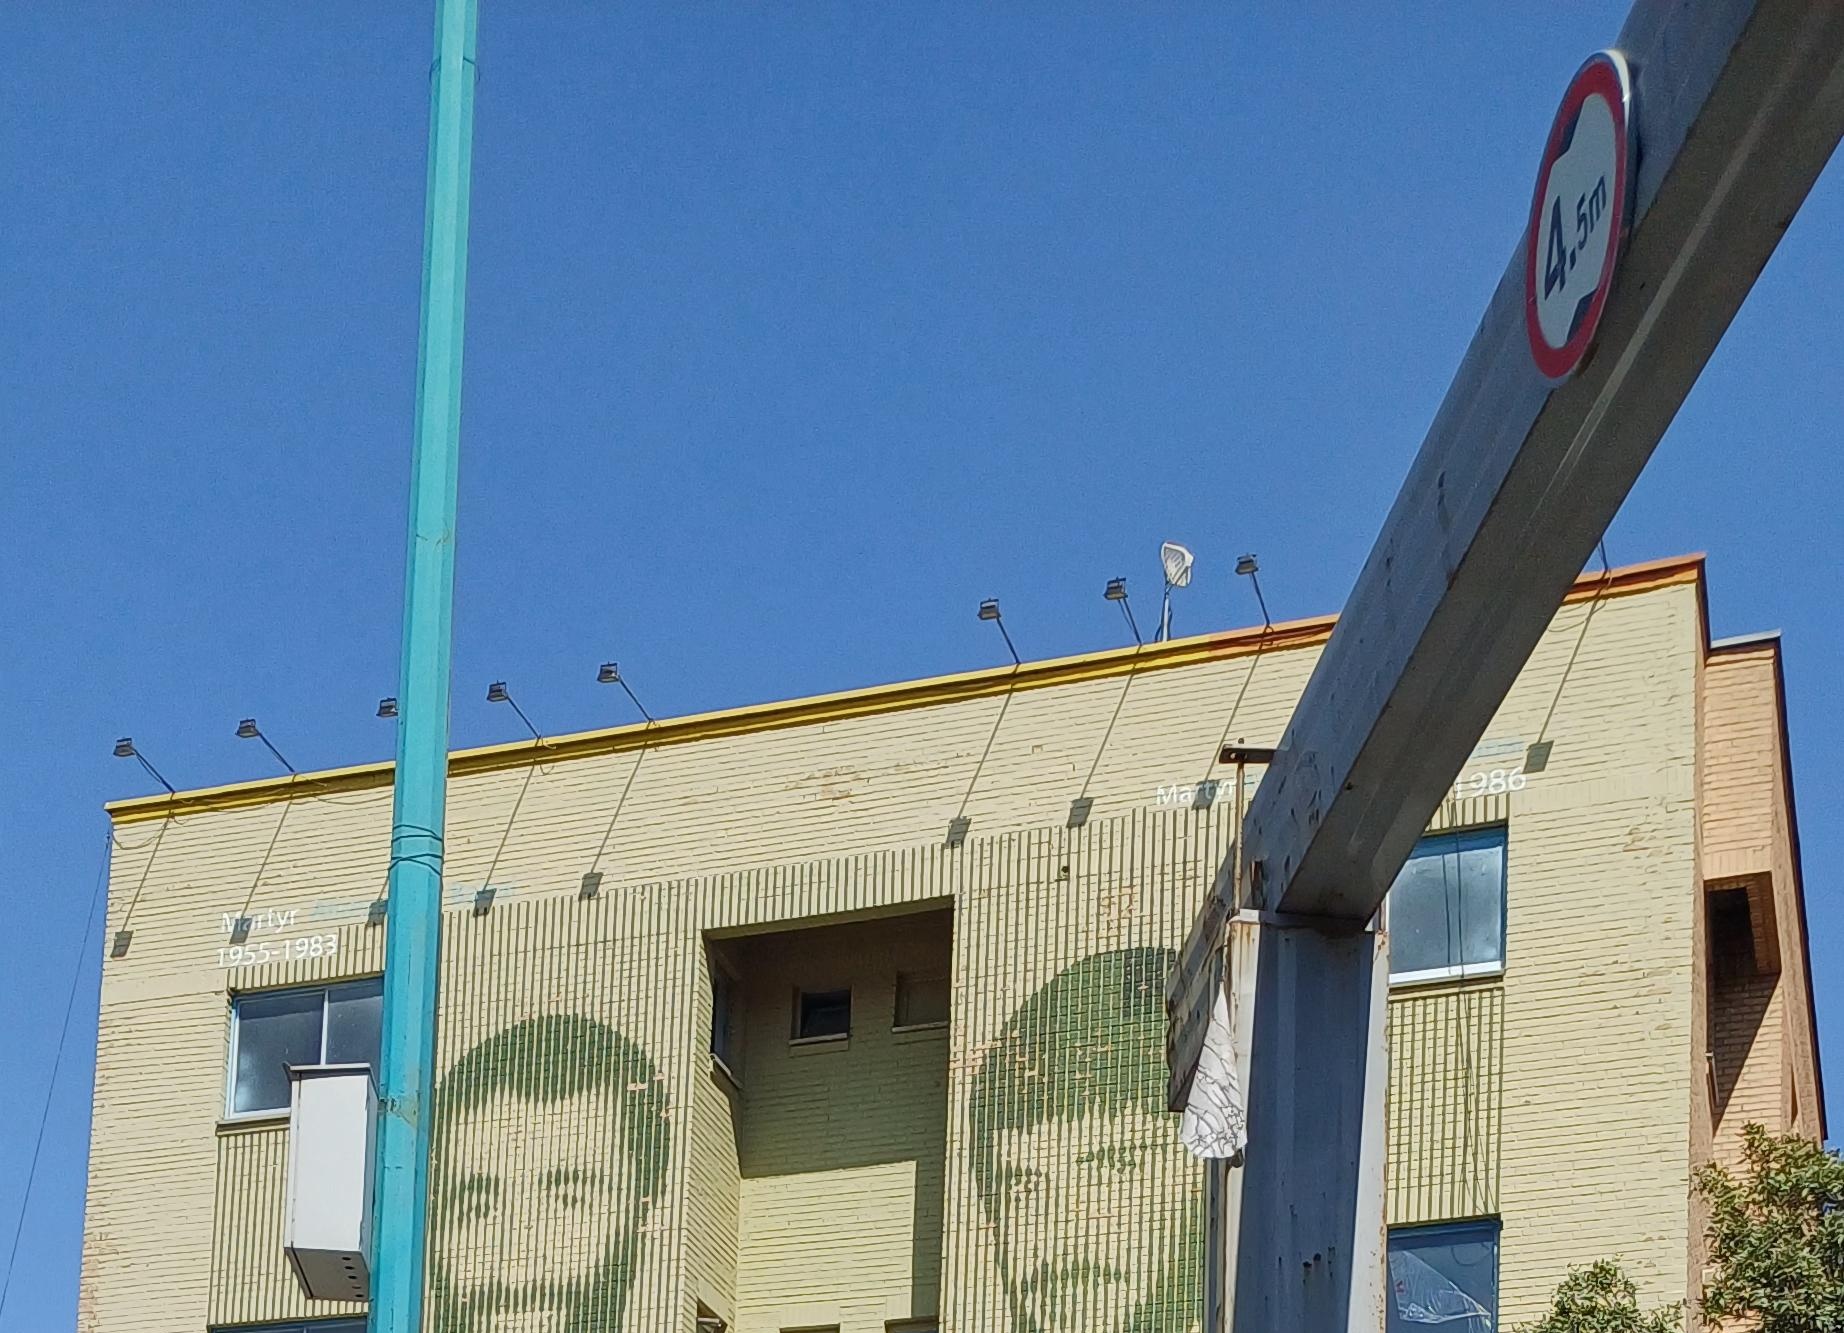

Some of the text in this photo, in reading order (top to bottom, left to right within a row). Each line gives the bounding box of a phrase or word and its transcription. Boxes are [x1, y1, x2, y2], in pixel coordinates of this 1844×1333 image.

[1543, 175, 1607, 301] 4.5m
[220, 906, 299, 933] Martyr
[216, 933, 339, 967] 1955-1983
